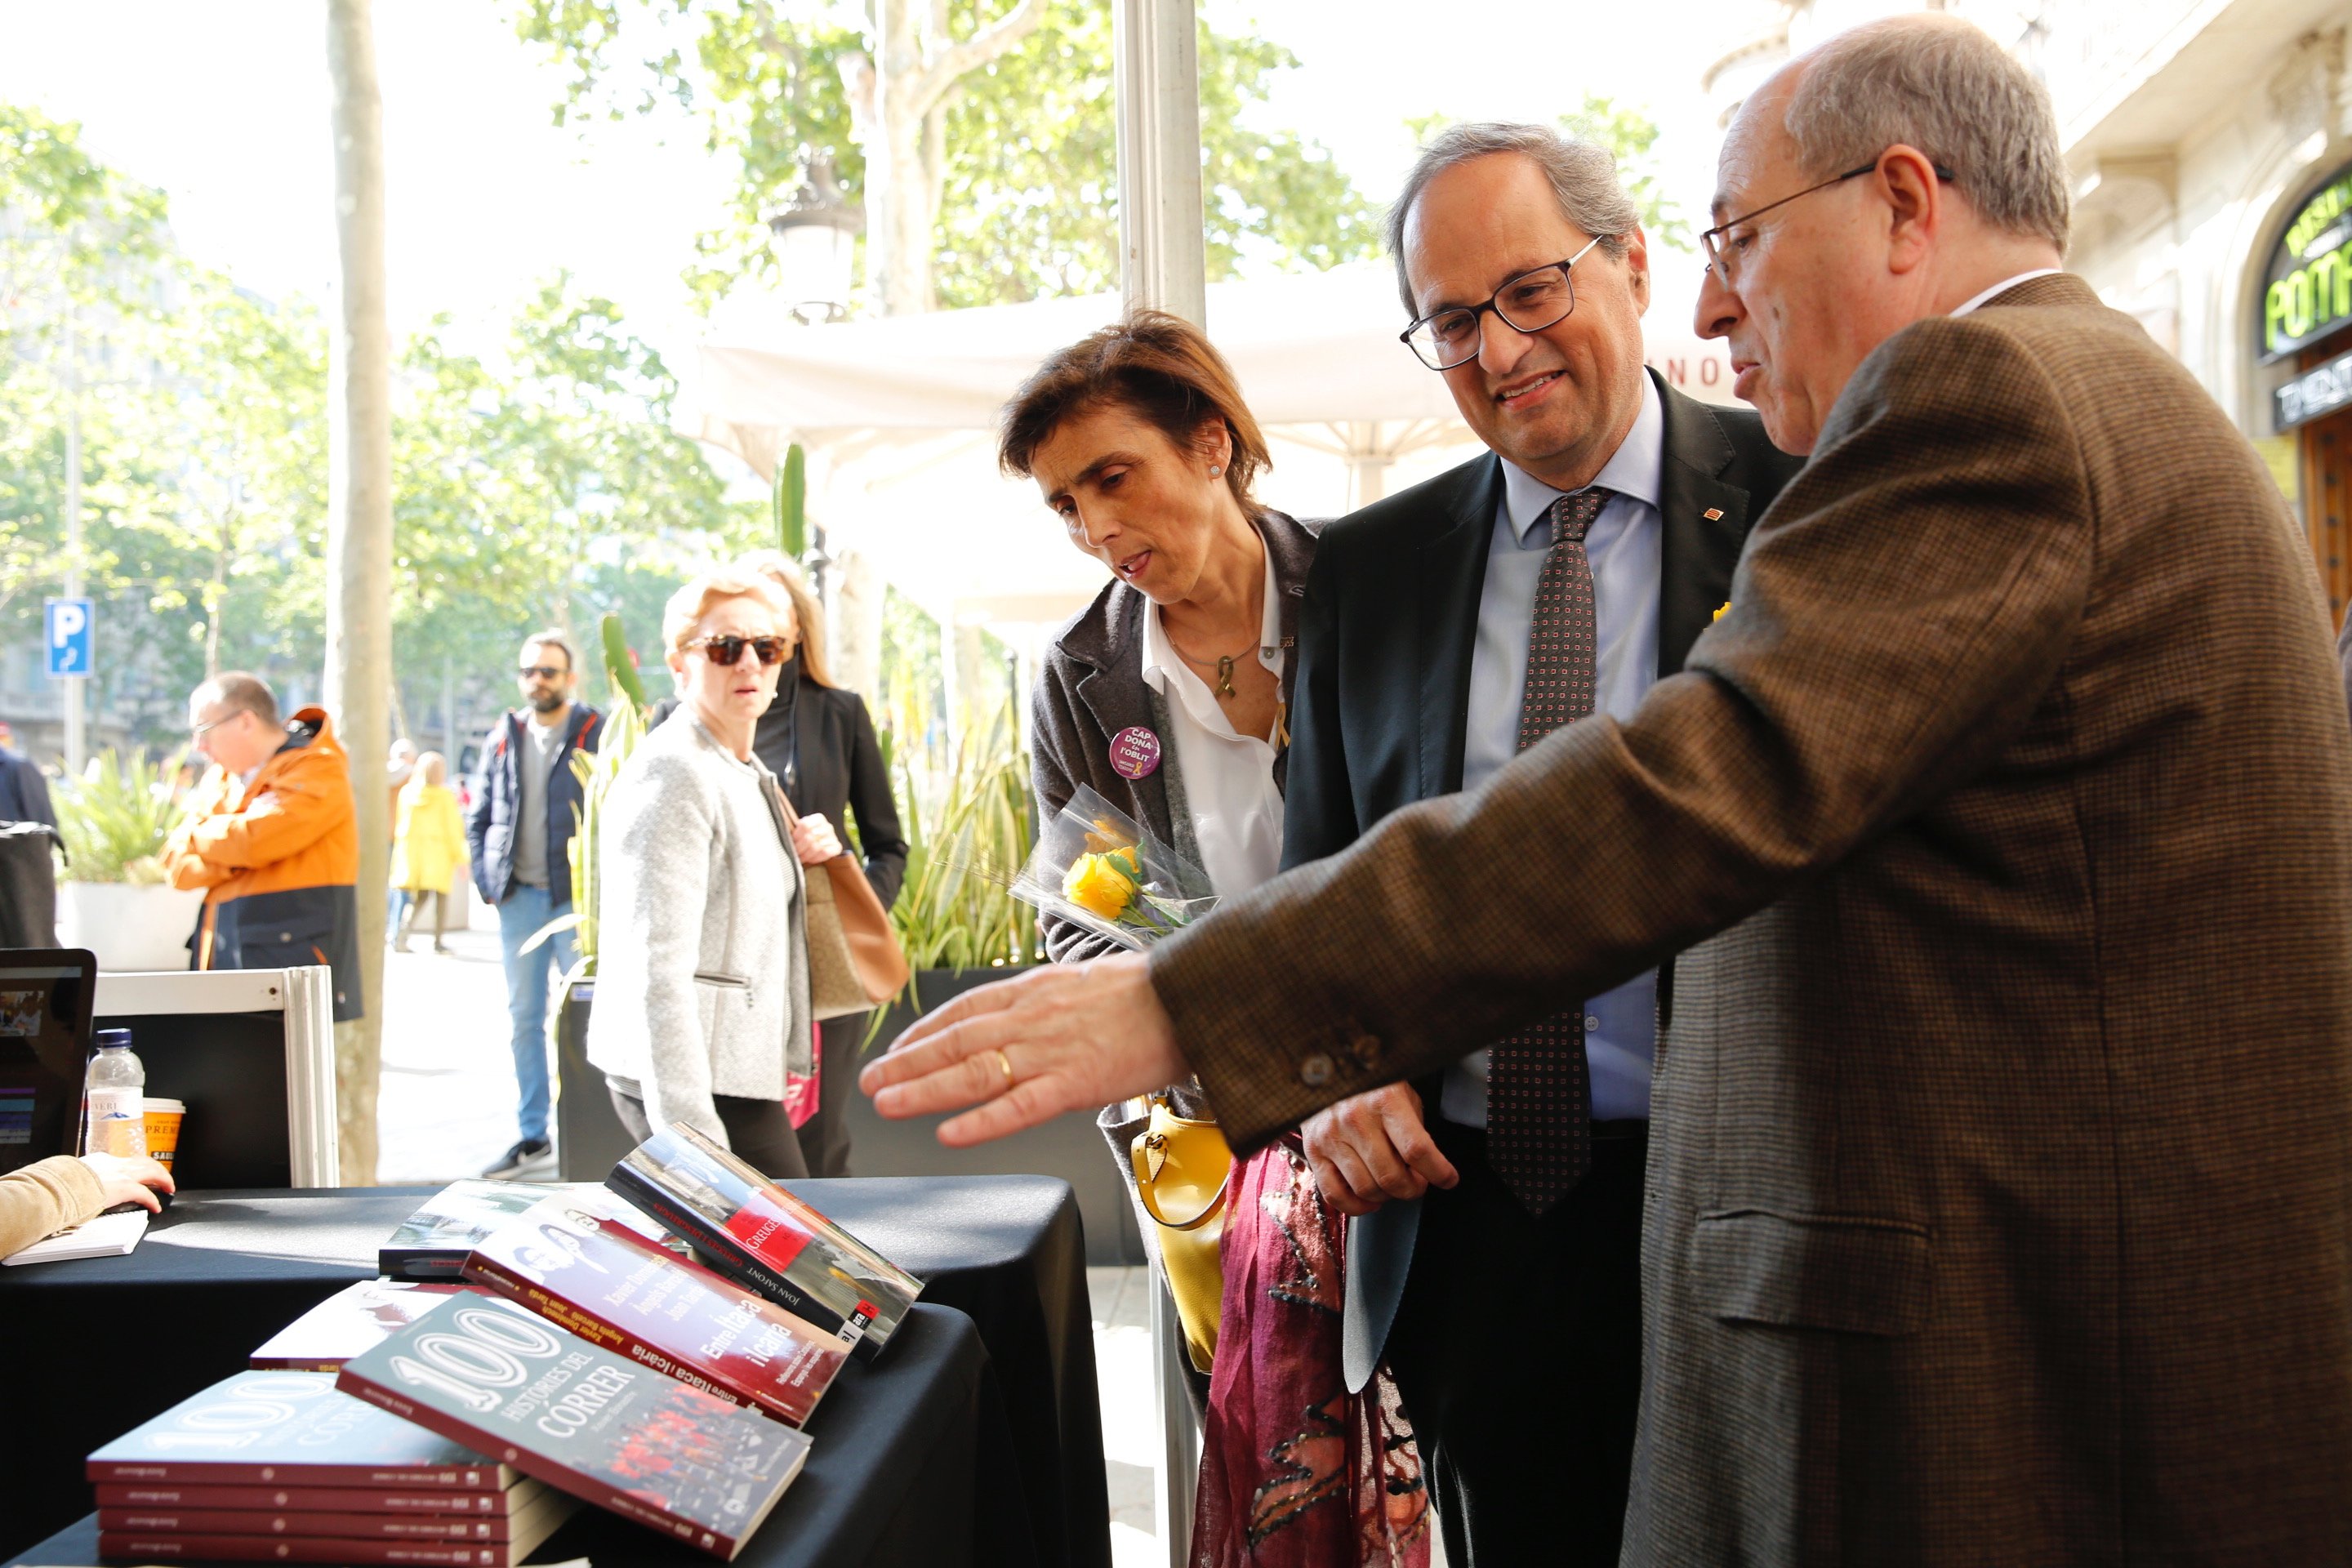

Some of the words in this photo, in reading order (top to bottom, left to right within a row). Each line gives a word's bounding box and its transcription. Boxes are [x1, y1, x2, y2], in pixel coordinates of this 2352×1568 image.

[1649, 357, 1719, 386] NO
[52, 604, 86, 648] P
[1125, 734, 1152, 750] DONA
[1132, 728, 1151, 740] CAP
[746, 1267, 779, 1293] SAFONT
[777, 1287, 800, 1307] JOAN
[699, 1326, 737, 1361] Entre
[387, 1307, 563, 1414] 100
[561, 1350, 595, 1374] DEL
[630, 1343, 670, 1374] Icària
[537, 1365, 636, 1439] CÓRRER
[710, 1386, 738, 1405] Entre
